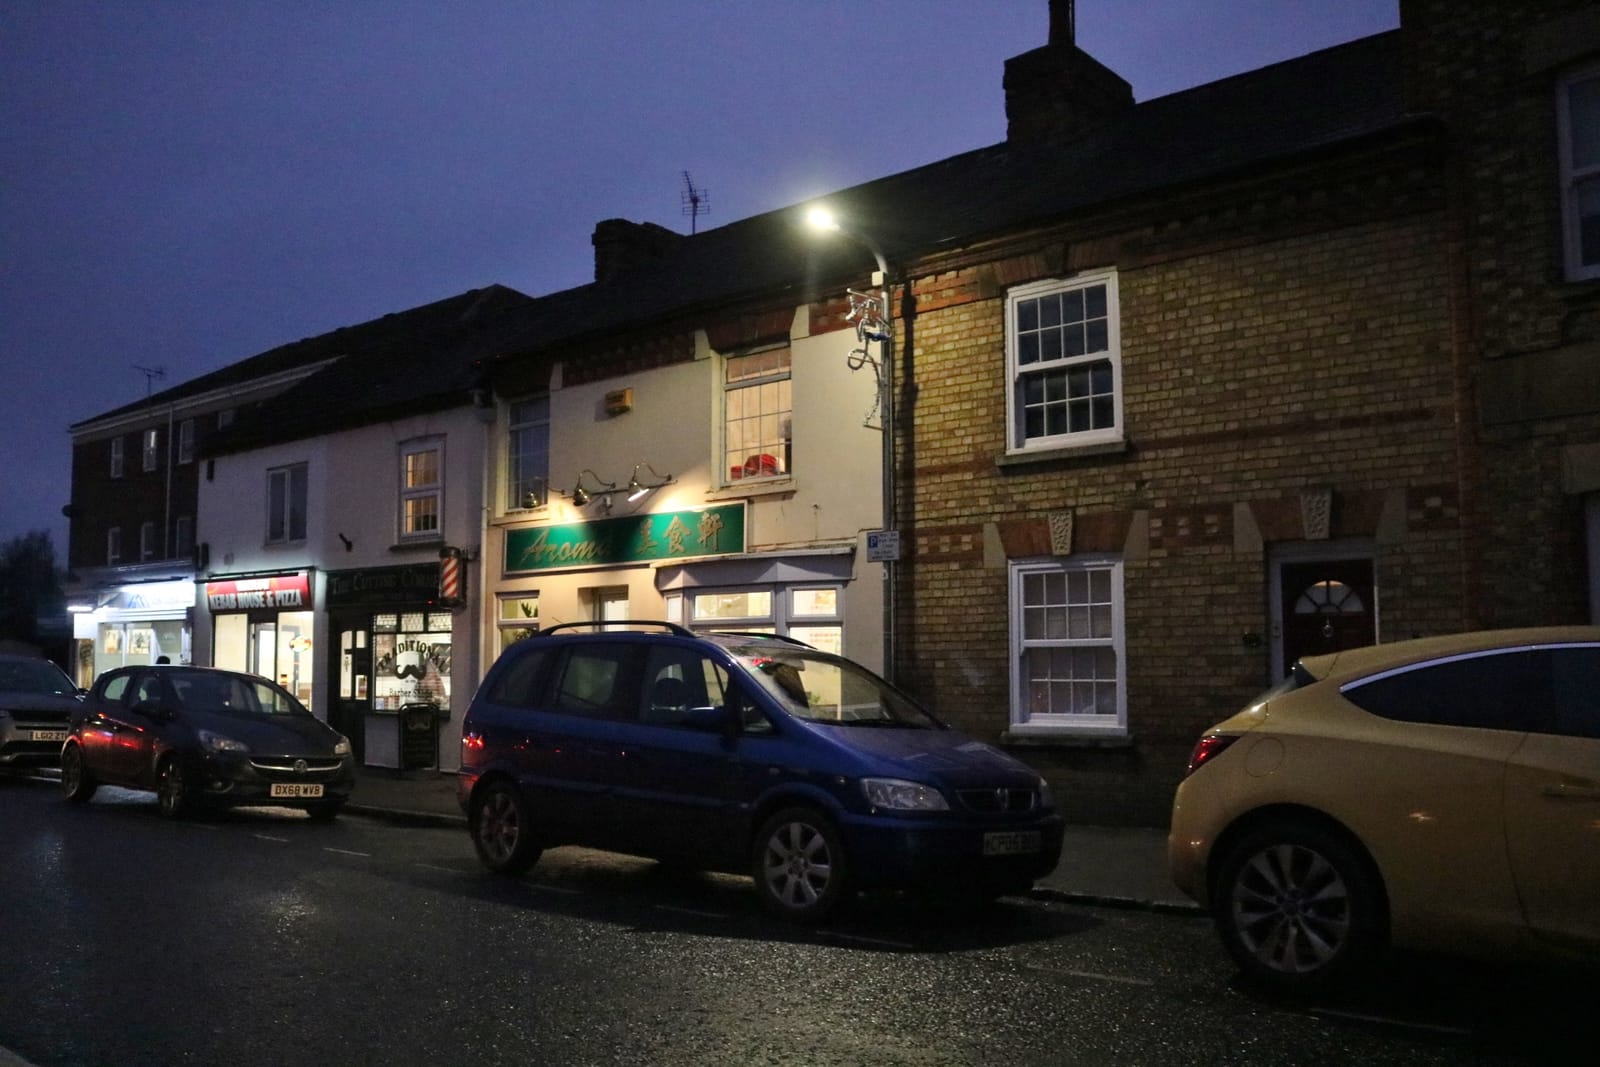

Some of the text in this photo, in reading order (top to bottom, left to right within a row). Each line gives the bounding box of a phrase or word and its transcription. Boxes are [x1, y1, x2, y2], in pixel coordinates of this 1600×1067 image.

[519, 528, 611, 567] Aroma
[638, 513, 724, 554] 美食軒
[210, 589, 302, 609] KEBAB HOUSE & PIZZA
[276, 785, 301, 795] DX68
